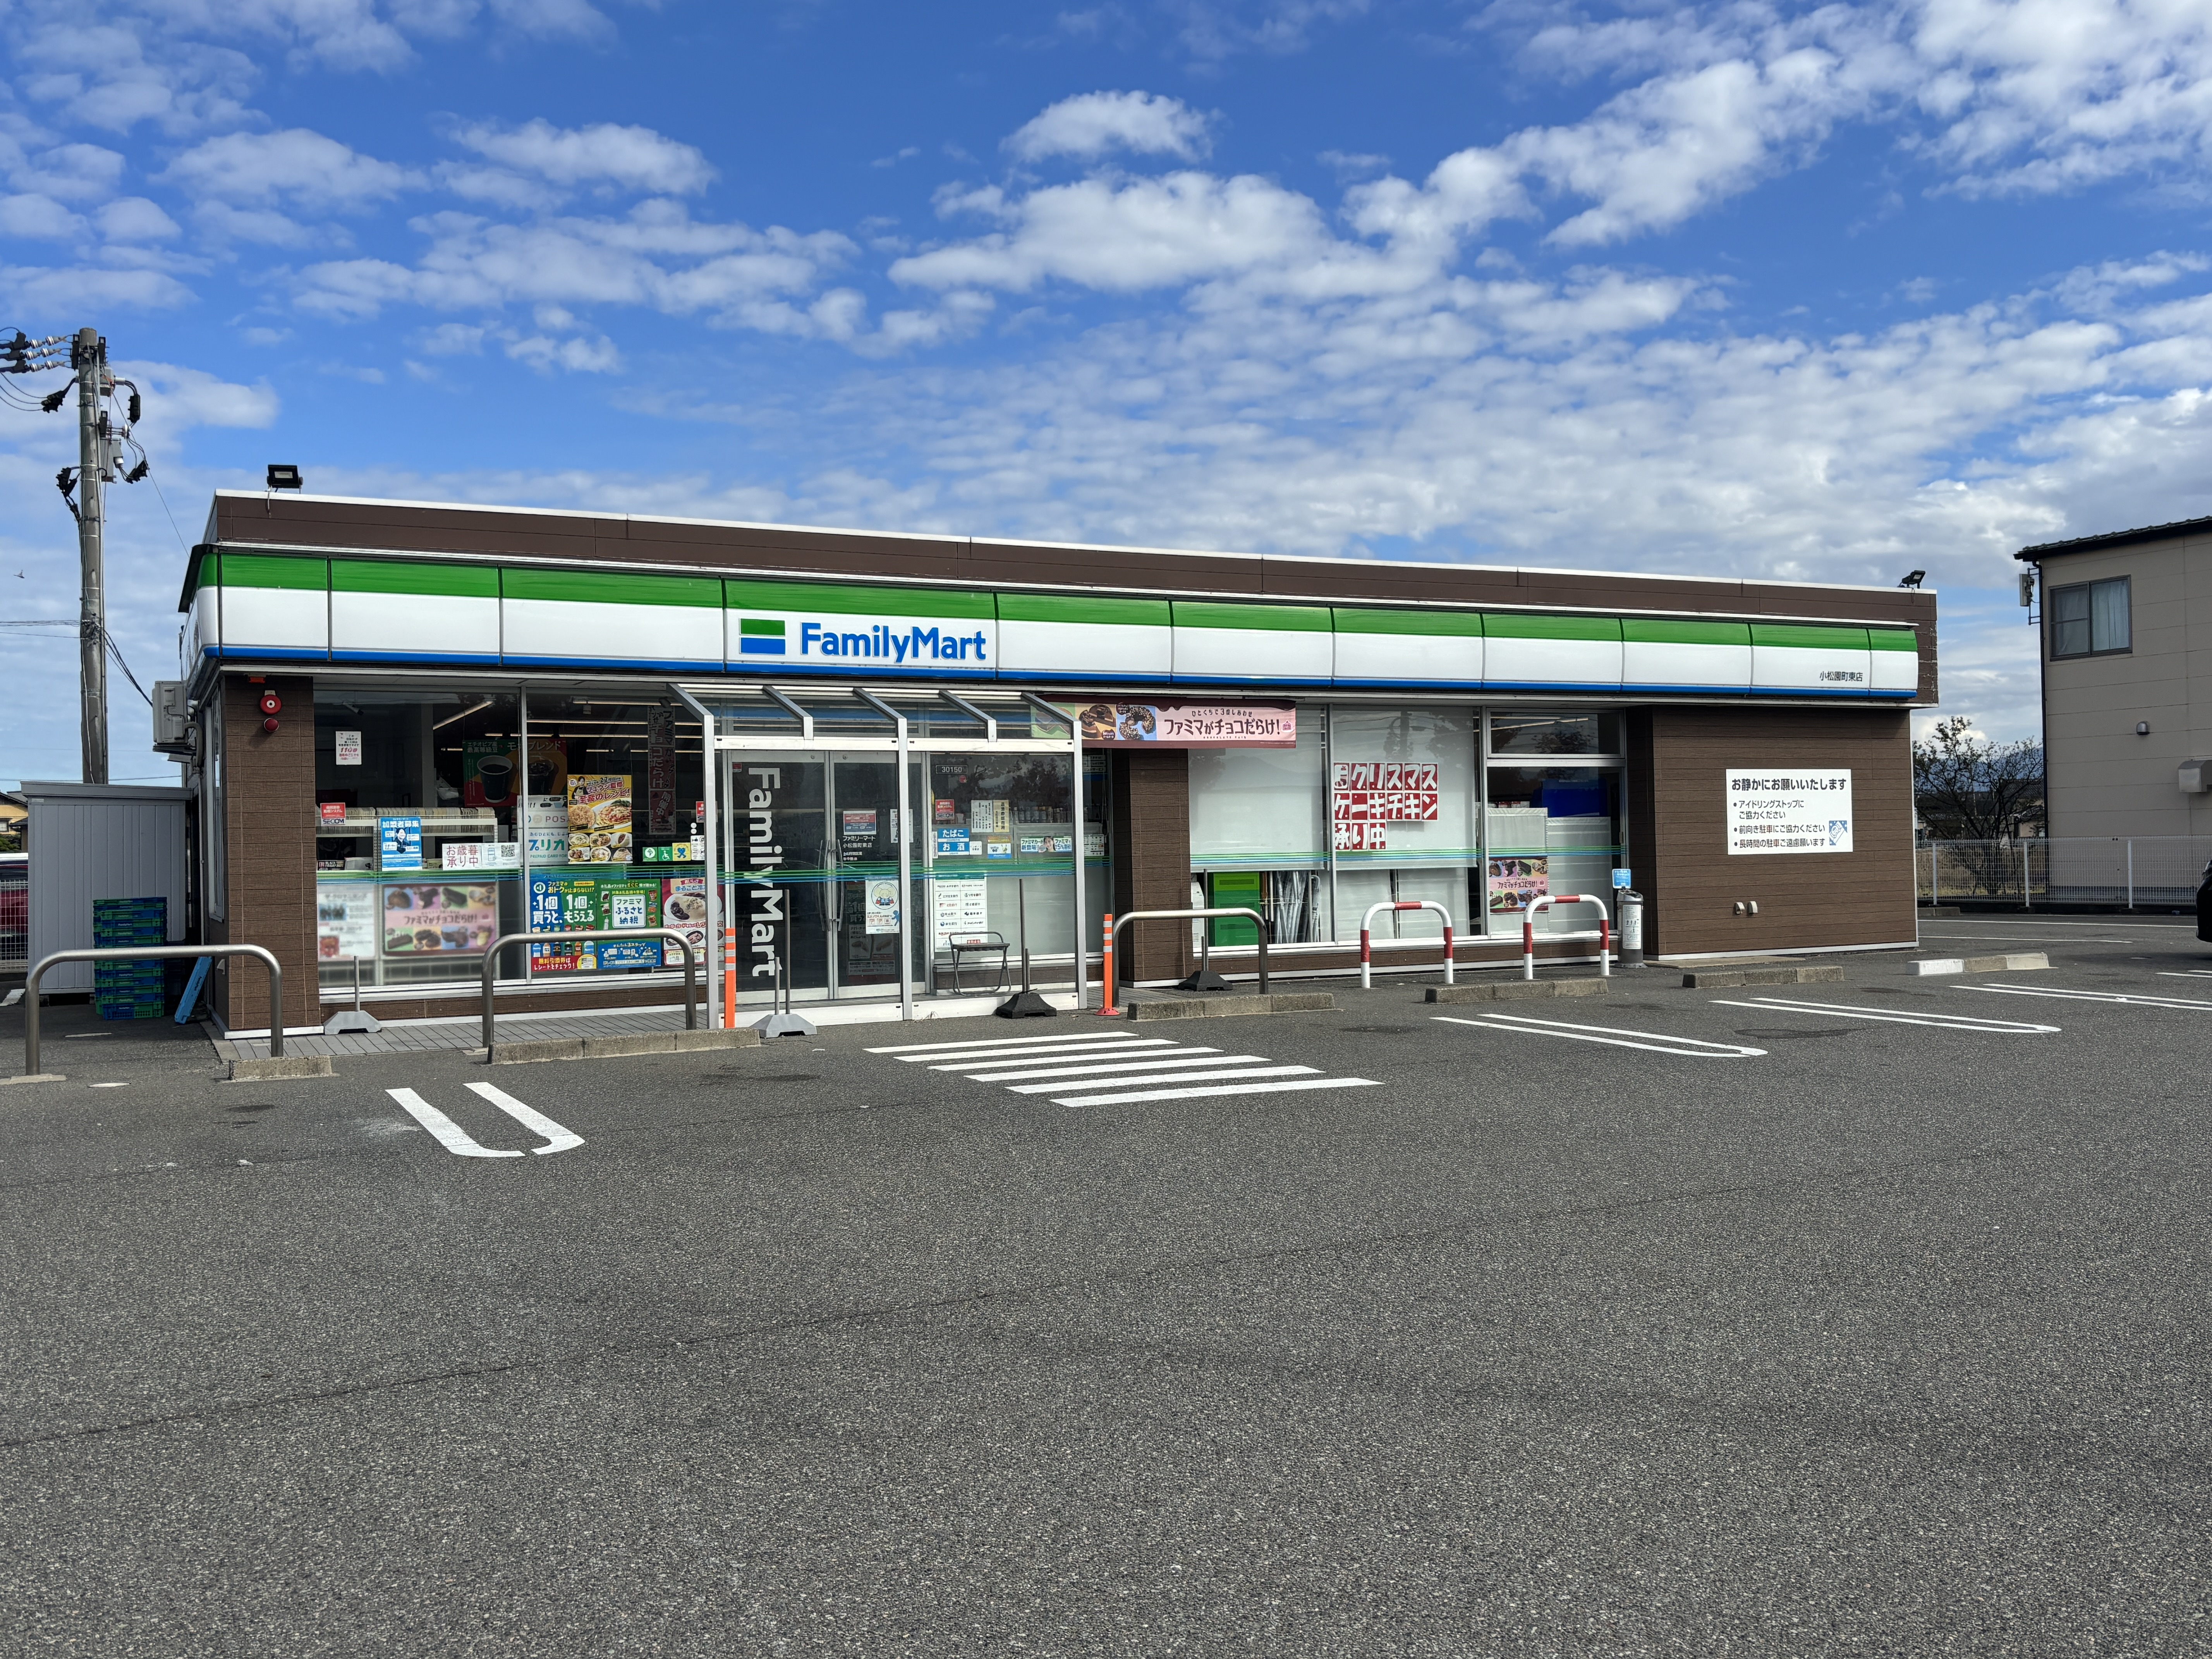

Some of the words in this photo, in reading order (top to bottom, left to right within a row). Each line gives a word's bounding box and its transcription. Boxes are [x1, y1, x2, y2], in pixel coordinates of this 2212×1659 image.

[800, 622, 986, 663] FamilyMart
[1164, 718, 1280, 735] ファミマがチョコだらけ!
[507, 740, 561, 750] モブレンド
[1351, 764, 1437, 790] クリスマス
[1731, 778, 1847, 791] お静かにお願いいたします
[1739, 800, 1804, 809] アイドリングストップに
[1739, 811, 1786, 819] ご協力ください
[943, 829, 964, 838] たばこ
[1739, 824, 1826, 834] 前向き駐車にご協力ください
[1335, 823, 1386, 850] 承り中
[1739, 838, 1826, 848] 長時間の駐車ご遠慮願います
[447, 845, 478, 856] お歳暮
[447, 856, 478, 867] 承り中
[744, 768, 785, 977] FamilyMart
[536, 894, 558, 910] 1個
[566, 894, 587, 910] 1個
[533, 910, 563, 924] 買うと、
[564, 910, 595, 923] もらえる
[615, 907, 643, 915] ふるさと
[619, 915, 639, 924] 納税
